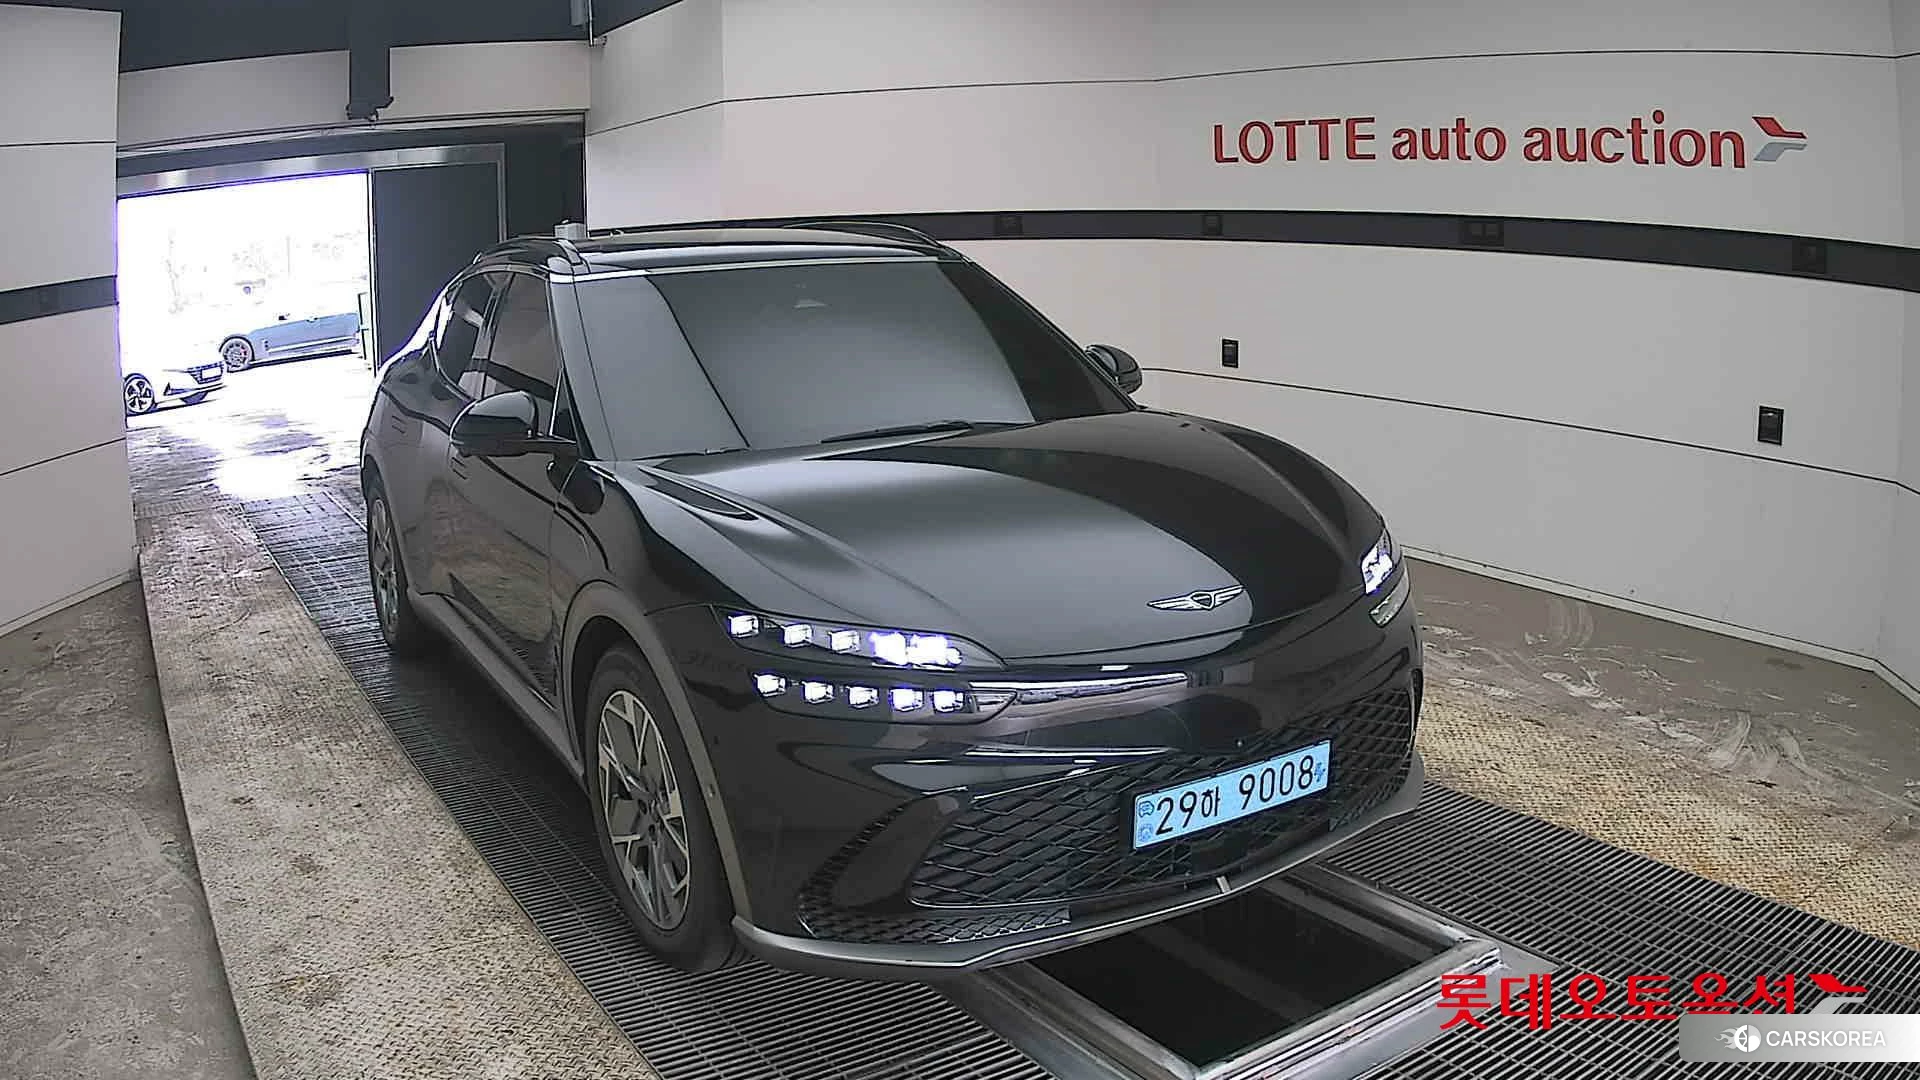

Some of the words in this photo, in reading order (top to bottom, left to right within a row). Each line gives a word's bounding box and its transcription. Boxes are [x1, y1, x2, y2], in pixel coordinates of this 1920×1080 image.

[1213, 117, 1376, 163] LOTTE
[1391, 117, 1507, 162] auto
[1523, 109, 1747, 169] auction
[1155, 786, 1221, 835] 29하
[1239, 755, 1314, 810] 9008
